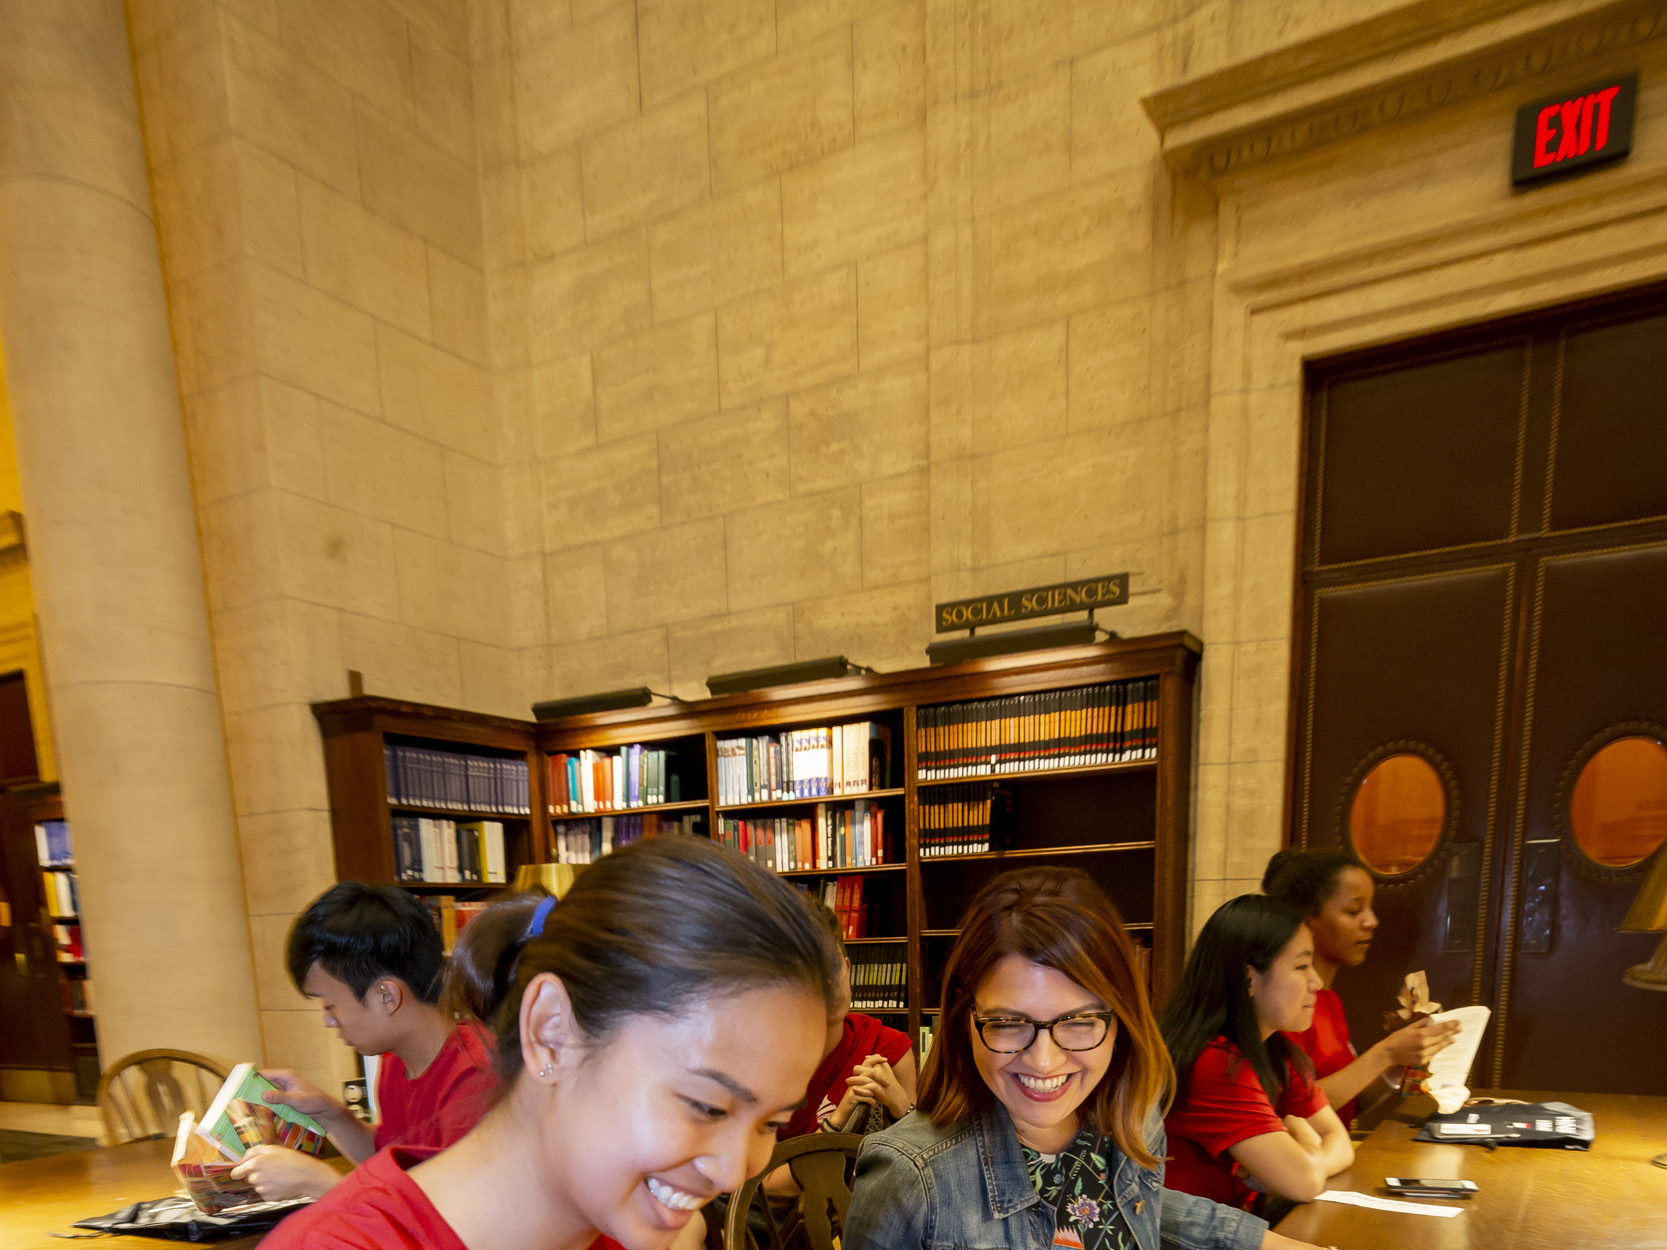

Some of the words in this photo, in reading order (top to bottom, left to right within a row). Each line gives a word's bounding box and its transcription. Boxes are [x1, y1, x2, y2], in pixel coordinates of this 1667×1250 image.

[1533, 85, 1621, 168] EXIT
[942, 598, 1015, 626] SOCIAL
[1021, 579, 1121, 613] SCIENCES
